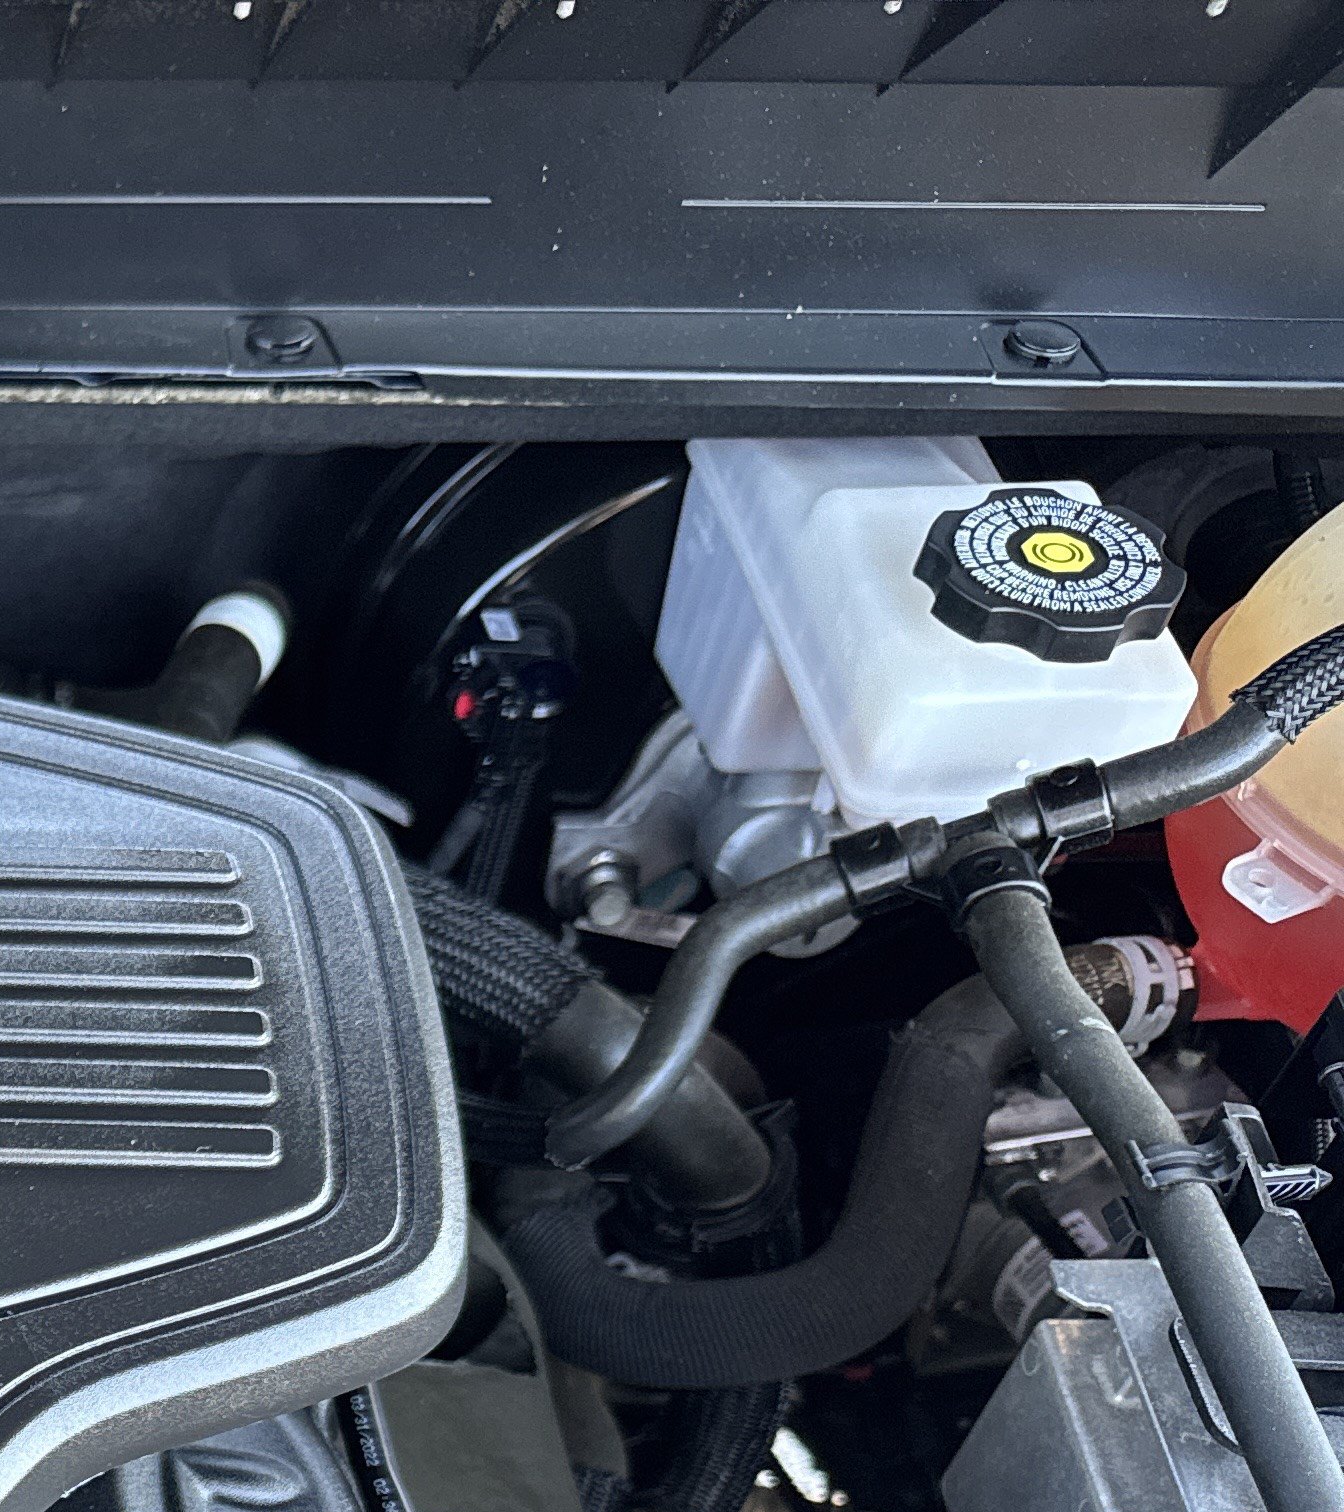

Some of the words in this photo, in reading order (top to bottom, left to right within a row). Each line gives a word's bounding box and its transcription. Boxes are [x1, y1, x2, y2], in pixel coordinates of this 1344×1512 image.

[1005, 496, 1023, 508] LE
[1023, 495, 1082, 511] BOUCHON
[1084, 505, 1124, 525] AVANT
[1119, 522, 1137, 535] LA
[1009, 506, 1029, 519] DU
[1029, 505, 1077, 520] LIQUIDE
[1079, 512, 1097, 526] DE
[1095, 520, 1130, 542] FREIN
[1051, 516, 1090, 534] BIDON
[985, 563, 1010, 579] CAP
[1003, 576, 1052, 598] BEFORE
[1112, 576, 1136, 592] USE
[1064, 577, 1105, 591] CLEAN
[994, 583, 1034, 604] FLUID
[1033, 596, 1070, 612] FROM
[1073, 601, 1083, 613] A
[1082, 595, 1129, 613] SEALED
